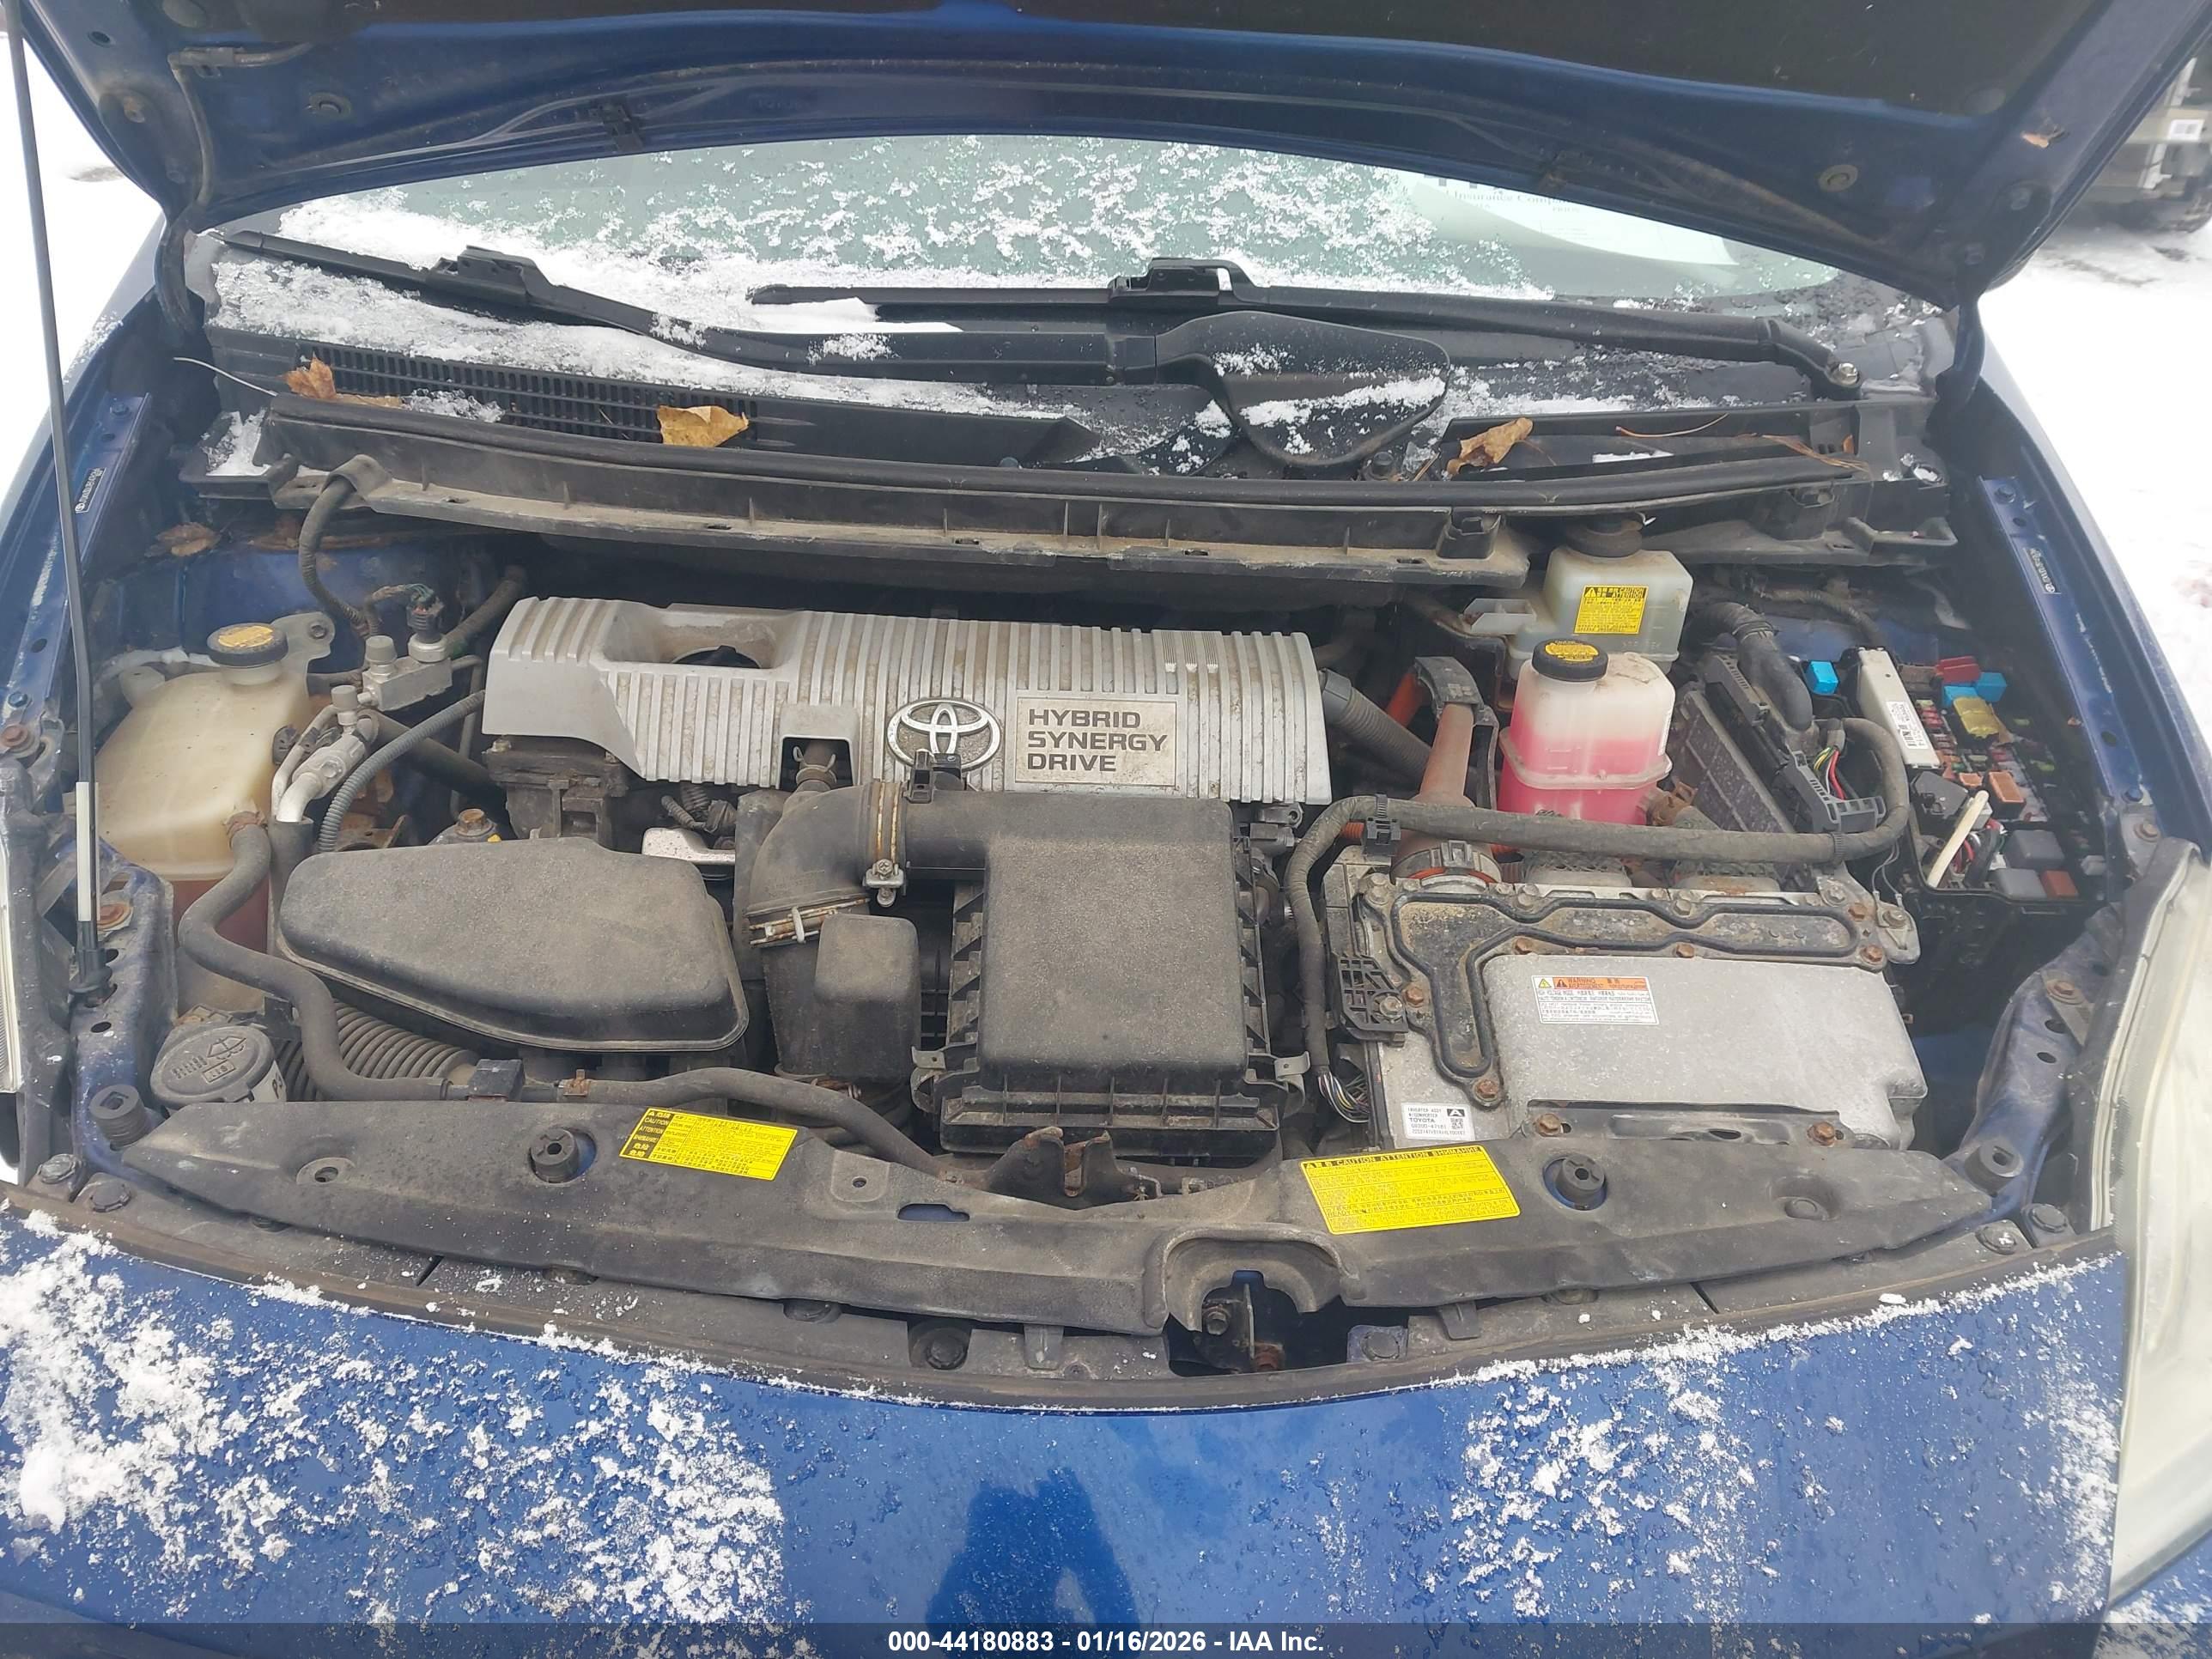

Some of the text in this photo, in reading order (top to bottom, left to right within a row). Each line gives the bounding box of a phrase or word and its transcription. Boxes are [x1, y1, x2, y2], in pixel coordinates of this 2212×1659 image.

[1029, 708, 1141, 728] HYBRID
[1028, 731, 1168, 751] SYNERGY
[1027, 753, 1117, 772] DRIVE
[1336, 1157, 1376, 1166] CAUTION
[1380, 1152, 1429, 1161] ATTENTION
